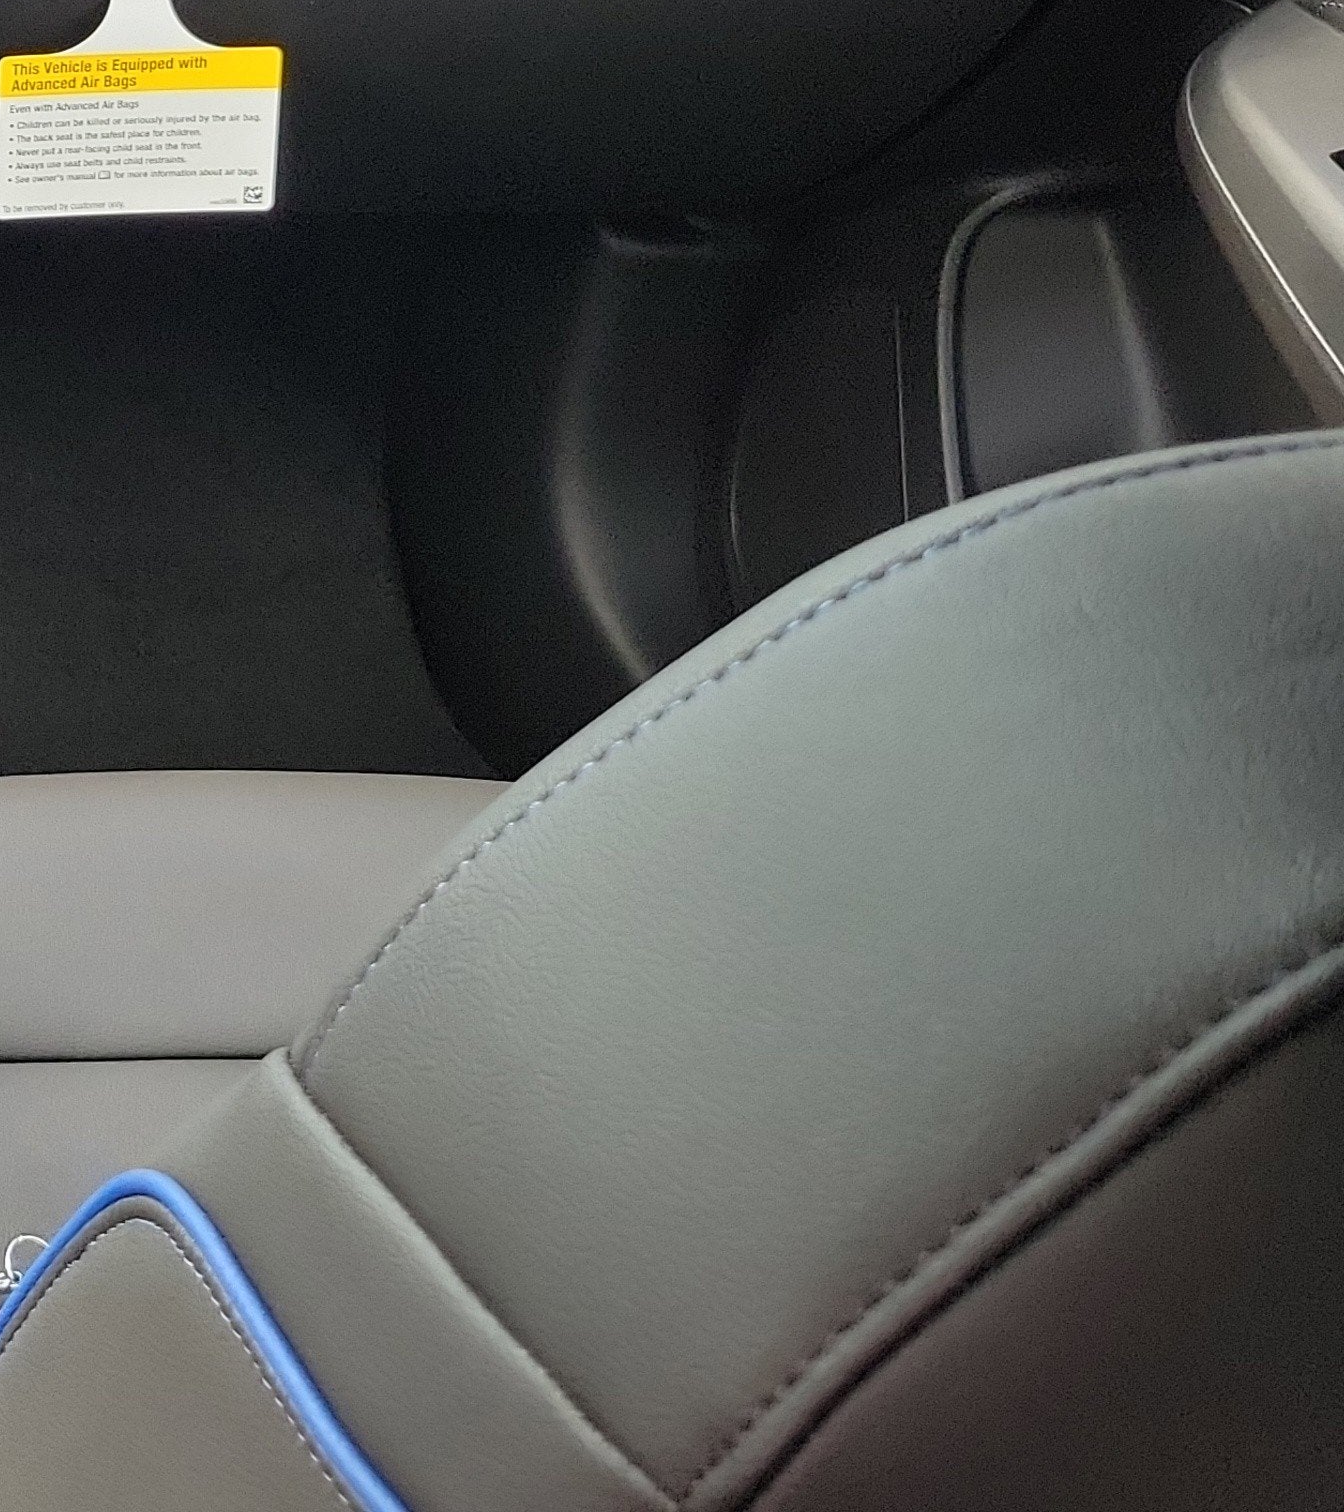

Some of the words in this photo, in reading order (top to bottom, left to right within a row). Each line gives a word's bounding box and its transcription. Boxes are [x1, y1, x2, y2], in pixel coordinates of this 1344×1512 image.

[12, 62, 40, 76] This
[44, 60, 92, 75] Vehicle
[96, 59, 108, 73] is
[112, 57, 174, 73] Equipped
[178, 56, 208, 69] with
[11, 77, 76, 92] Advanced
[80, 75, 100, 89] Air
[104, 75, 137, 90] Bags
[9, 104, 31, 114] Even
[34, 103, 53, 112] with
[55, 102, 100, 111] Advanced
[102, 100, 114, 109] Air
[117, 100, 140, 110] Bags
[17, 134, 32, 143] The
